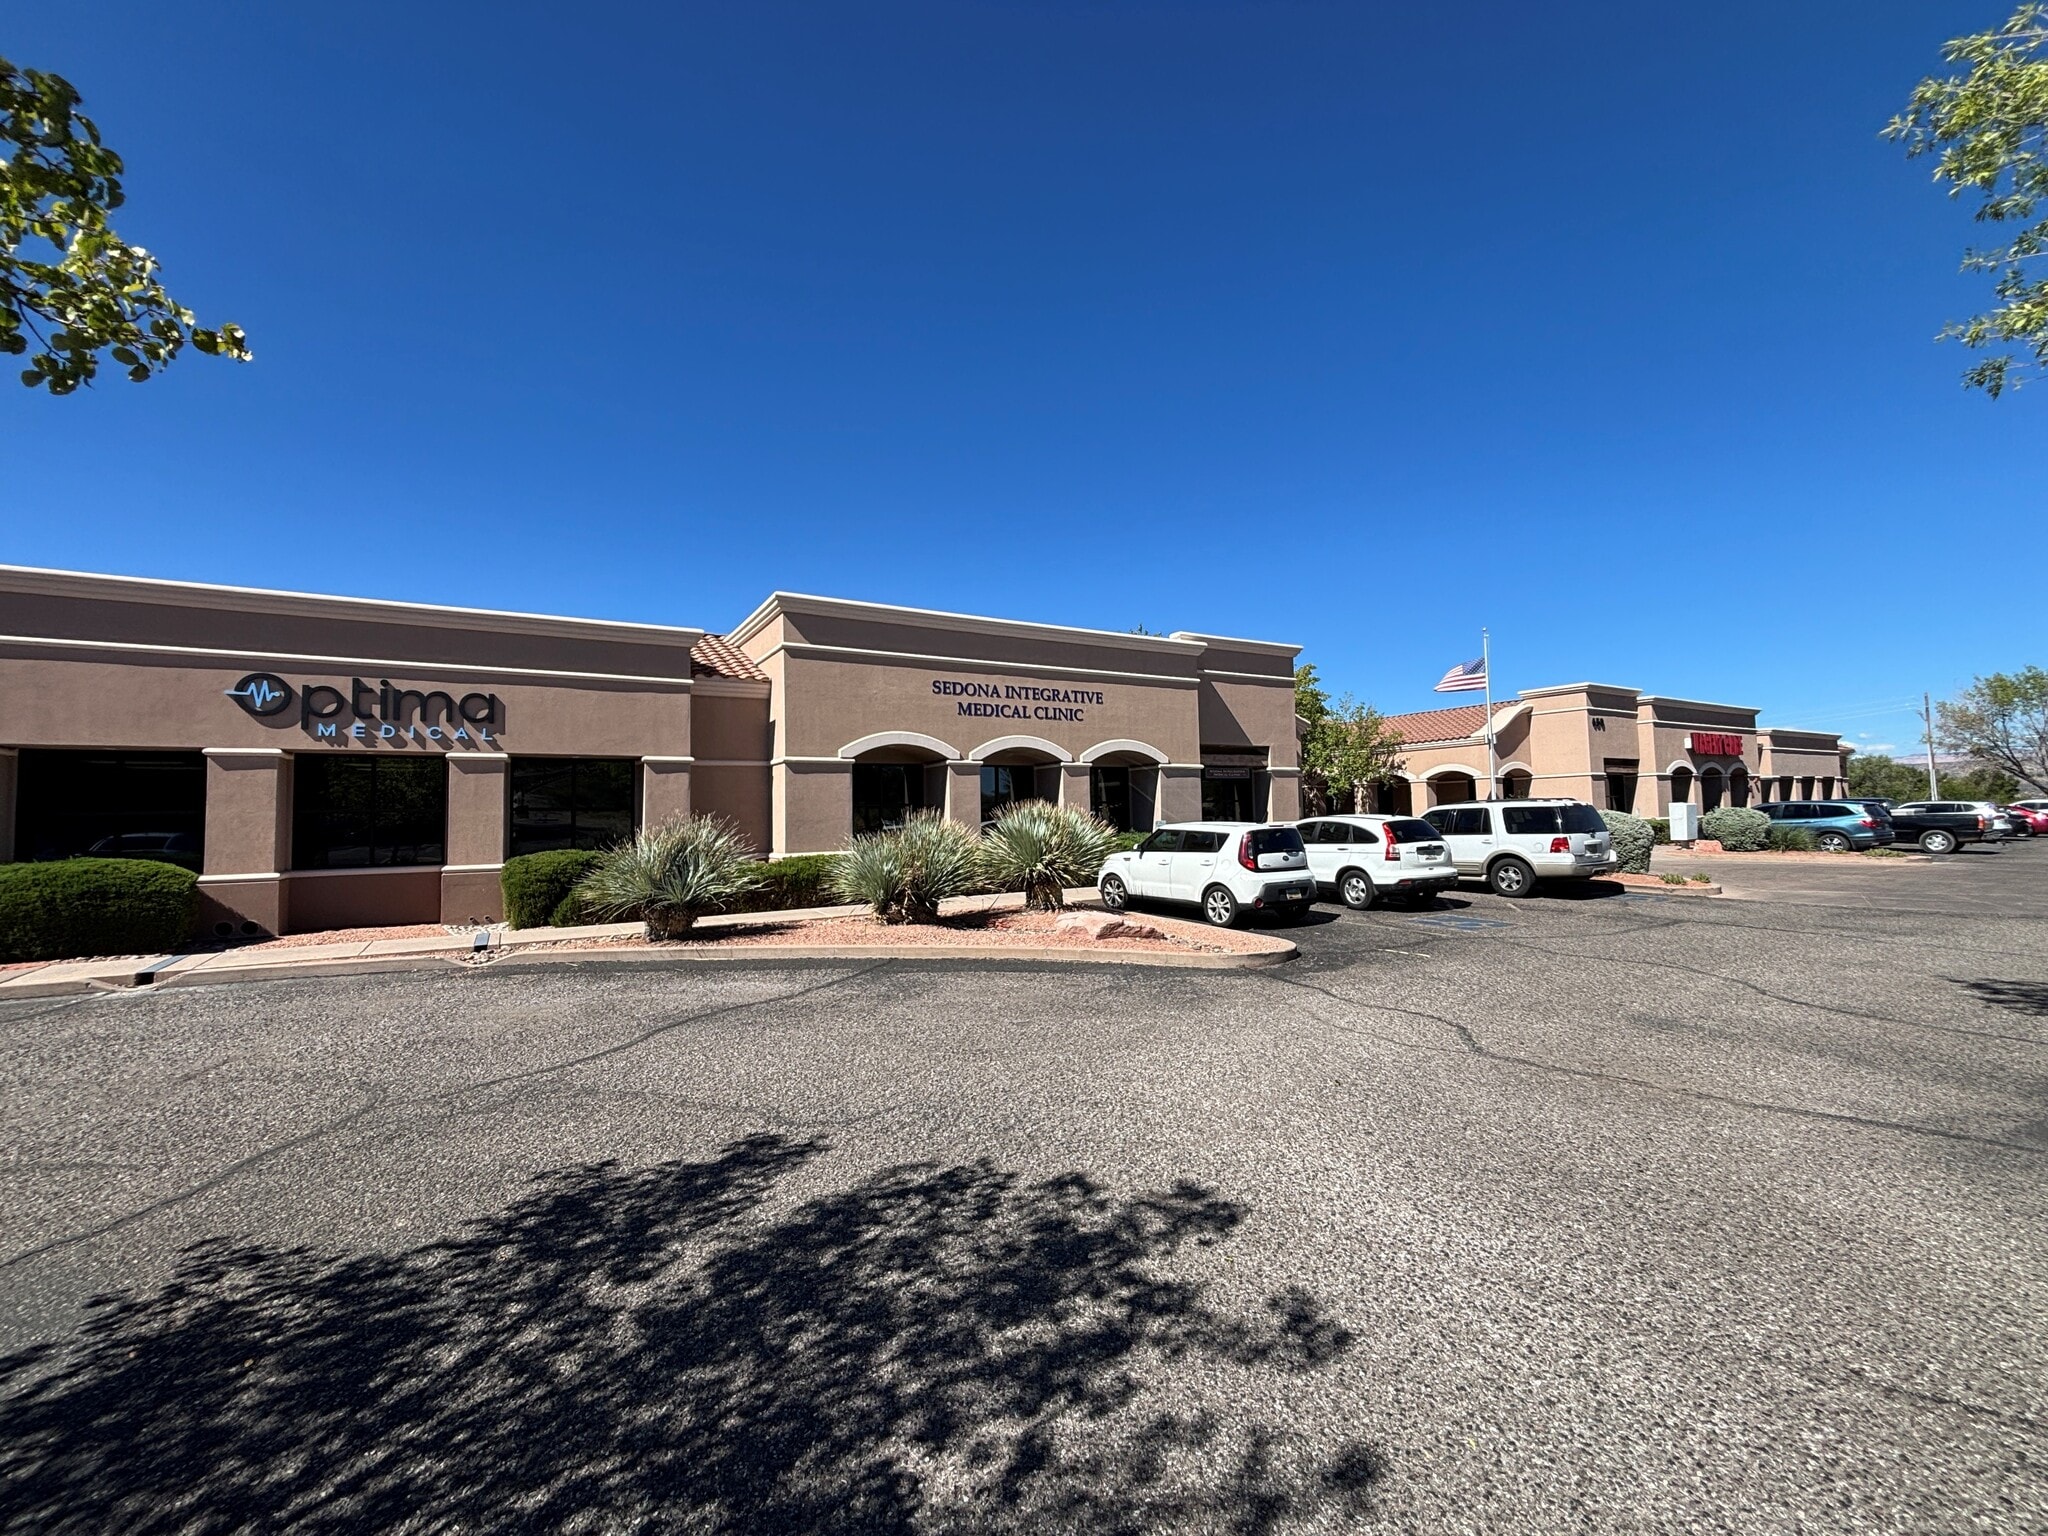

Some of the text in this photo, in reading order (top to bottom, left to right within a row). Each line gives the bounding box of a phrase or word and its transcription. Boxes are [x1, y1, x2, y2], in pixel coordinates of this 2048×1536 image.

[226, 672, 496, 730] Optima
[932, 680, 1104, 705] SEDONA INTEGRATIVE
[957, 702, 1084, 722] MEDICAL CLINIC
[317, 723, 493, 741] MEDICAL
